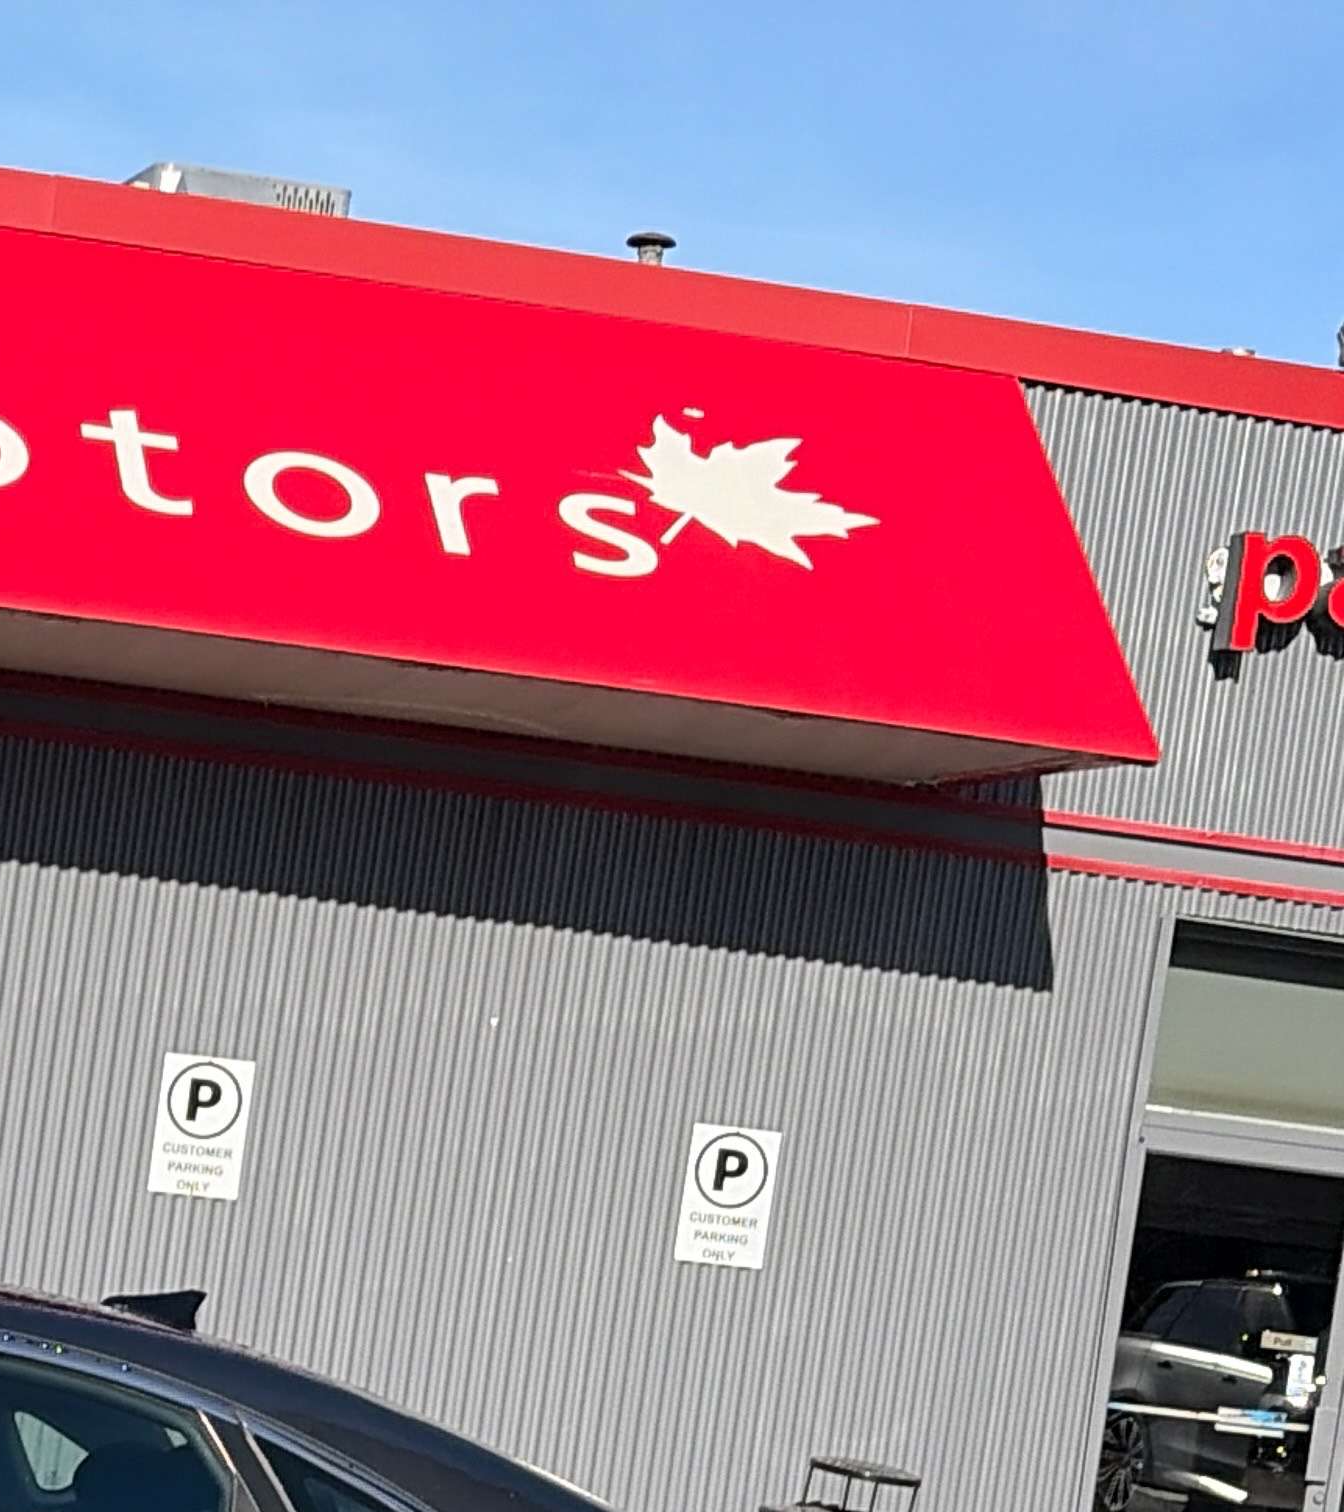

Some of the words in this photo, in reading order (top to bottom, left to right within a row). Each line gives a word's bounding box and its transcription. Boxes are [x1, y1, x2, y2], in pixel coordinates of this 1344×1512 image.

[1227, 530, 1344, 651] p
[186, 1077, 222, 1122] P
[162, 1142, 233, 1159] CUSTOMER
[167, 1161, 224, 1177] PARKING
[713, 1147, 748, 1191] P
[176, 1180, 210, 1193] ONLY
[689, 1211, 758, 1228] CUSTOMER
[693, 1230, 749, 1246] PARKING
[702, 1248, 735, 1261] ONLY
